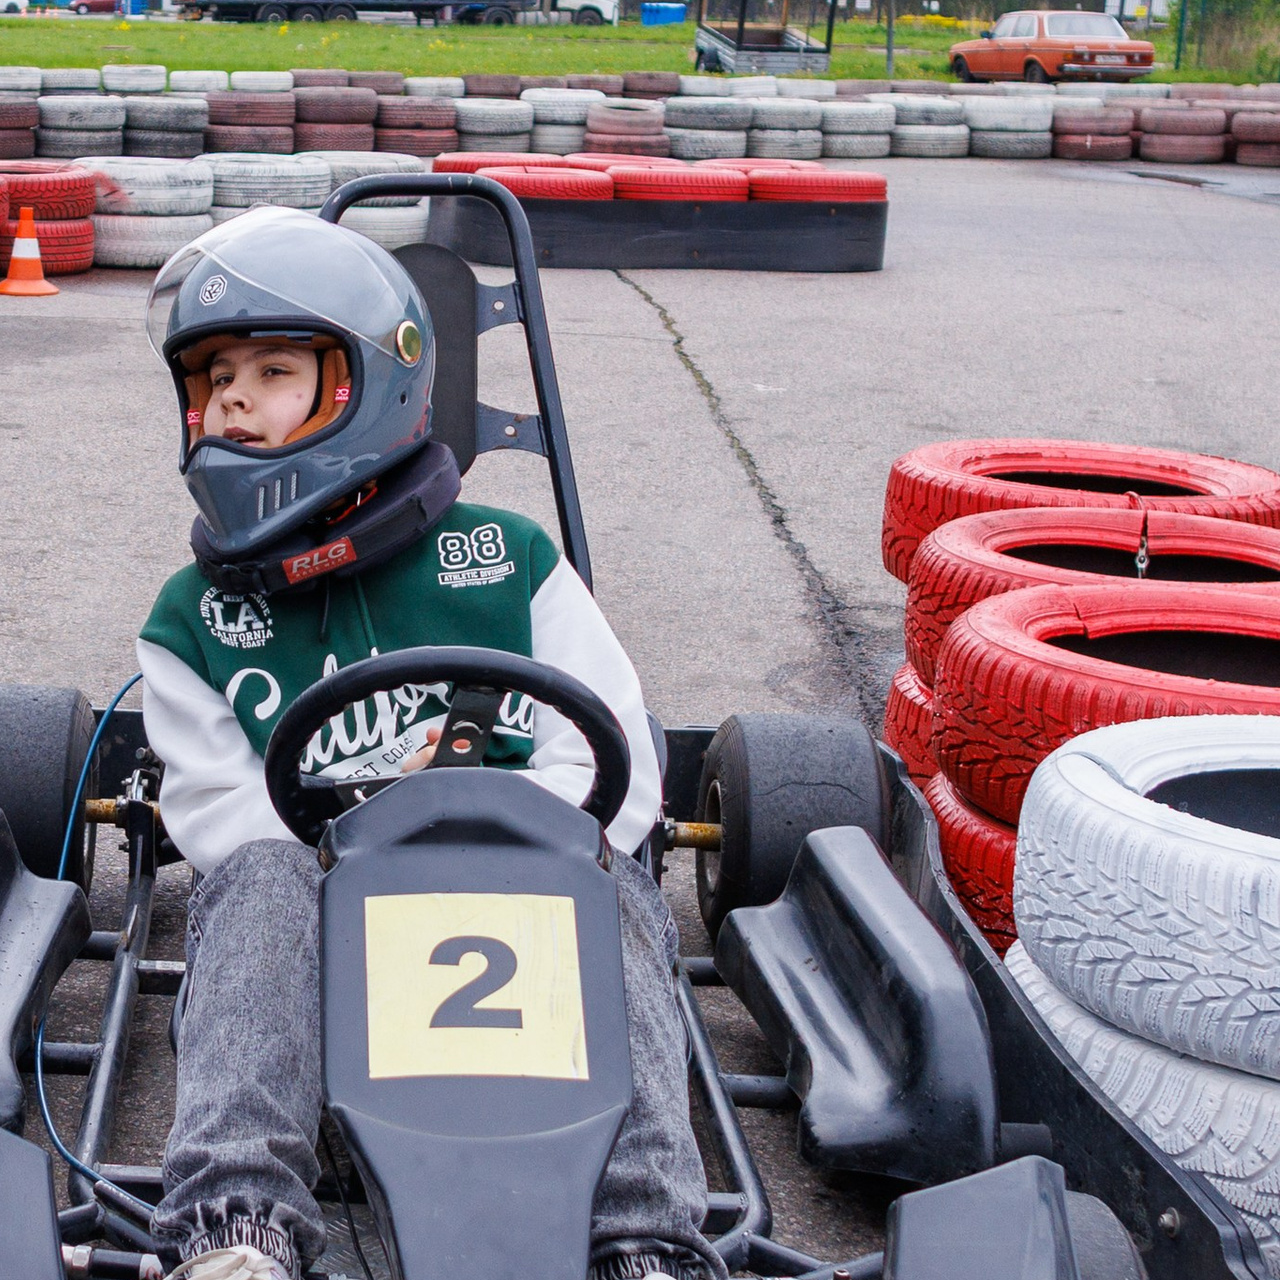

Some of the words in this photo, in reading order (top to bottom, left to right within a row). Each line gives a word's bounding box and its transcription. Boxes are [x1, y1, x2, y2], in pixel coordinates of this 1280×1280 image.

[292, 543, 347, 574] RLG
[438, 523, 506, 569] 88
[444, 571, 479, 582] ATHLETIC
[480, 565, 510, 579] DIVISION
[210, 601, 265, 633] LA
[210, 627, 274, 643] CALIFORNIA
[242, 639, 266, 649] COAST
[382, 737, 415, 765] COAS
[428, 935, 524, 1029] 2
